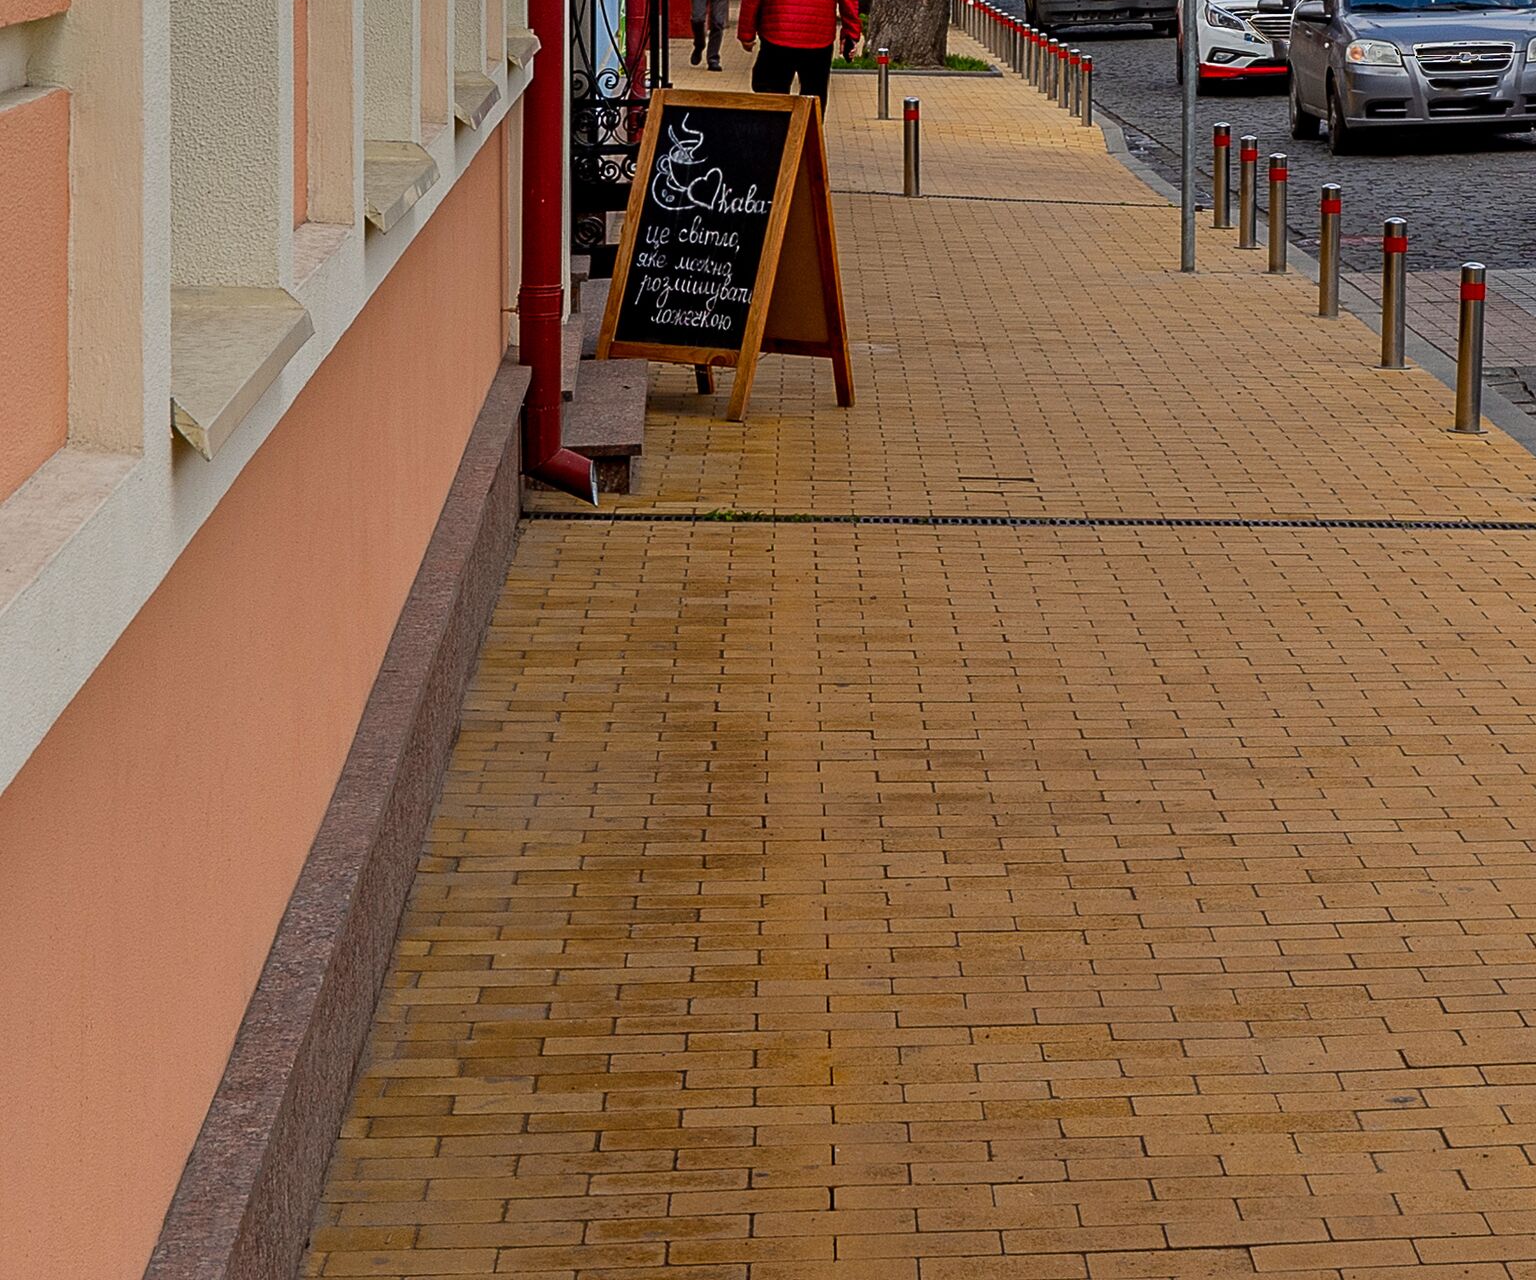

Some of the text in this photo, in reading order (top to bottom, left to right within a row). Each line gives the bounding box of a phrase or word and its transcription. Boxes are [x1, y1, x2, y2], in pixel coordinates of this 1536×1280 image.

[646, 215, 740, 254] це світло,
[635, 250, 666, 268] яке
